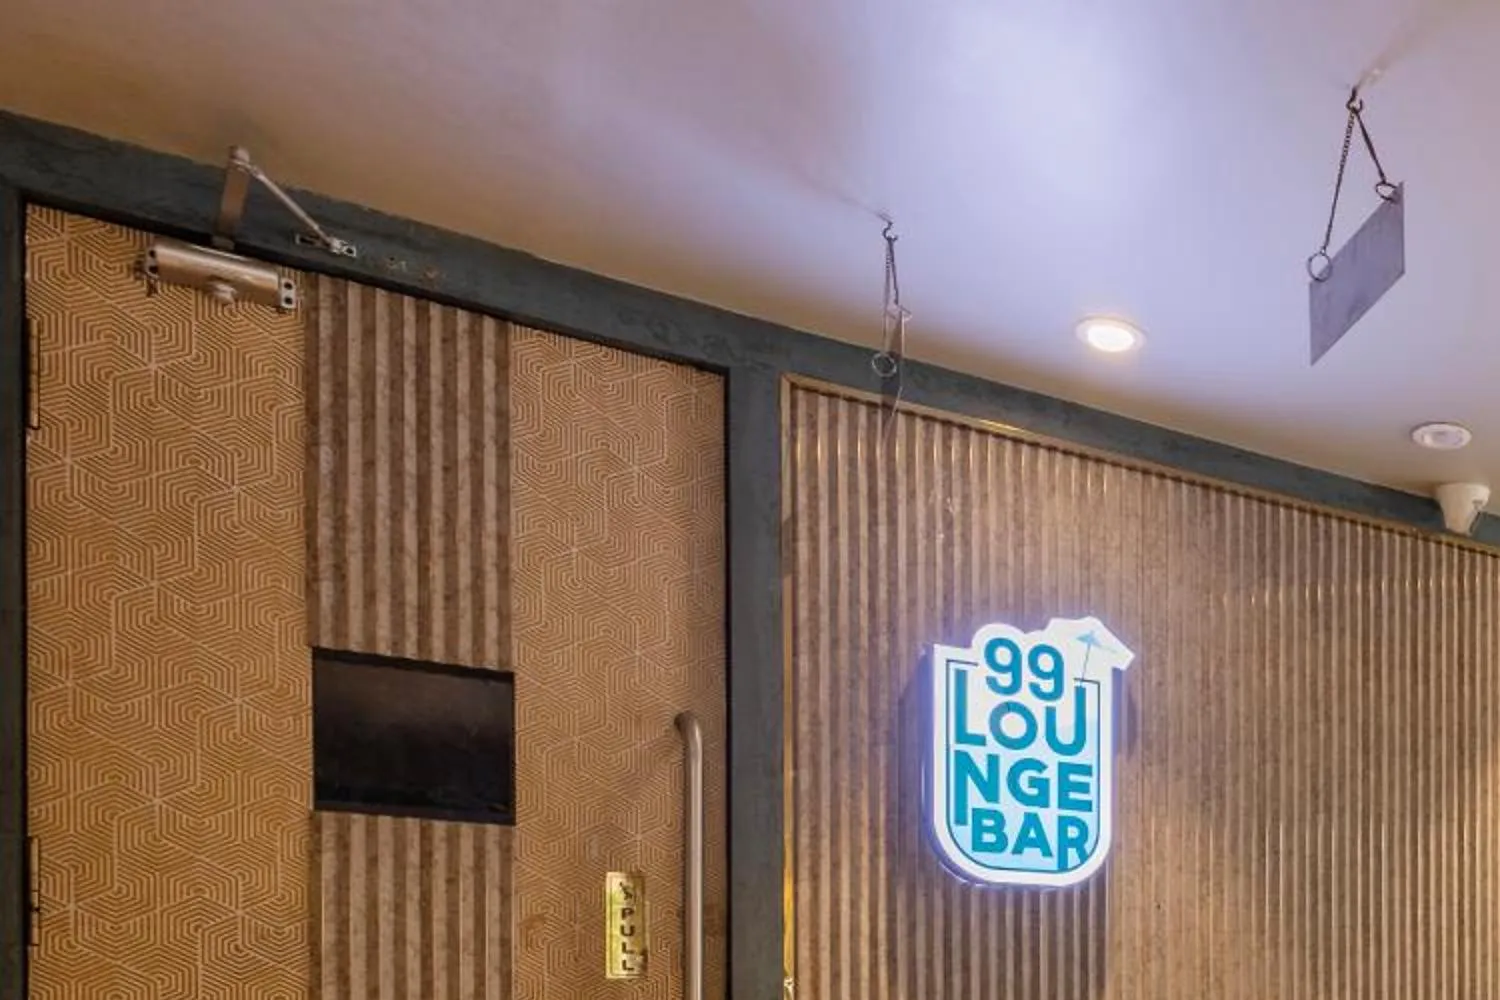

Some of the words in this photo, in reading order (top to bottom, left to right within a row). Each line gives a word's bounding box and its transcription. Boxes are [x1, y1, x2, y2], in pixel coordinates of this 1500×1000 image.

[984, 637, 1064, 701] 99
[953, 668, 1086, 756] LOU
[954, 750, 1093, 826] NGE
[971, 807, 1089, 871] BAR
[620, 907, 635, 972] PULL
